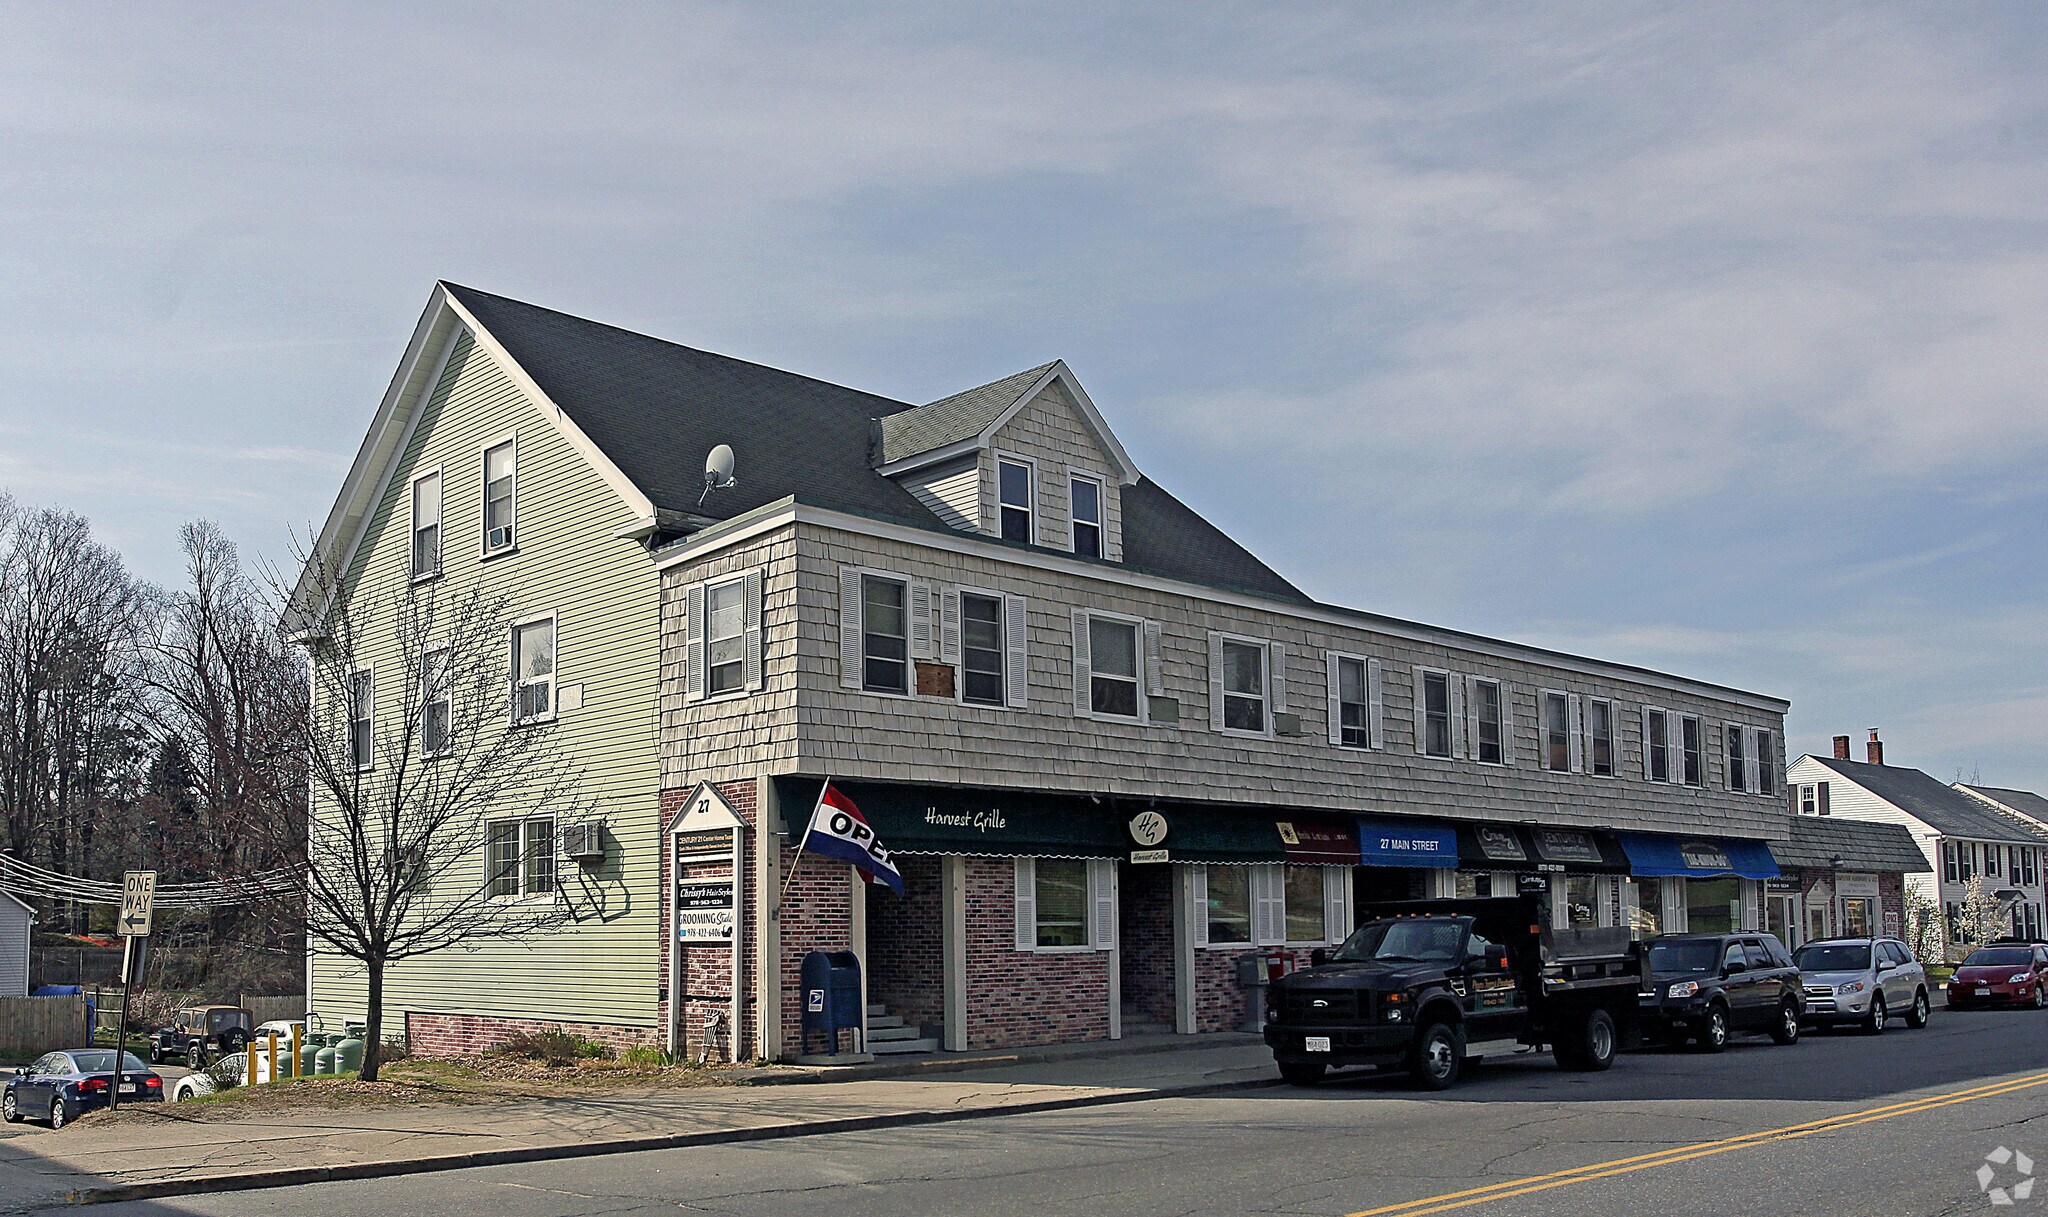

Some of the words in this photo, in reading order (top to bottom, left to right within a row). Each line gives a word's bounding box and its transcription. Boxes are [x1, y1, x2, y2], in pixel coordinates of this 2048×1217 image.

[698, 799, 709, 813] 27
[924, 807, 972, 826] Harvest
[974, 809, 1006, 833] Grille
[678, 836, 697, 844] CENTURY
[1380, 838, 1390, 849] 27
[1391, 839, 1410, 850] MAIN
[1412, 840, 1439, 850] STREET
[1133, 853, 1153, 861] Harvest
[1153, 852, 1167, 861] Grille
[128, 877, 151, 891] ONE
[680, 886, 706, 899] Chrissy's
[126, 895, 150, 909] WAY
[679, 913, 716, 924] GROOMING
[687, 928, 720, 937] 978-422-6406
